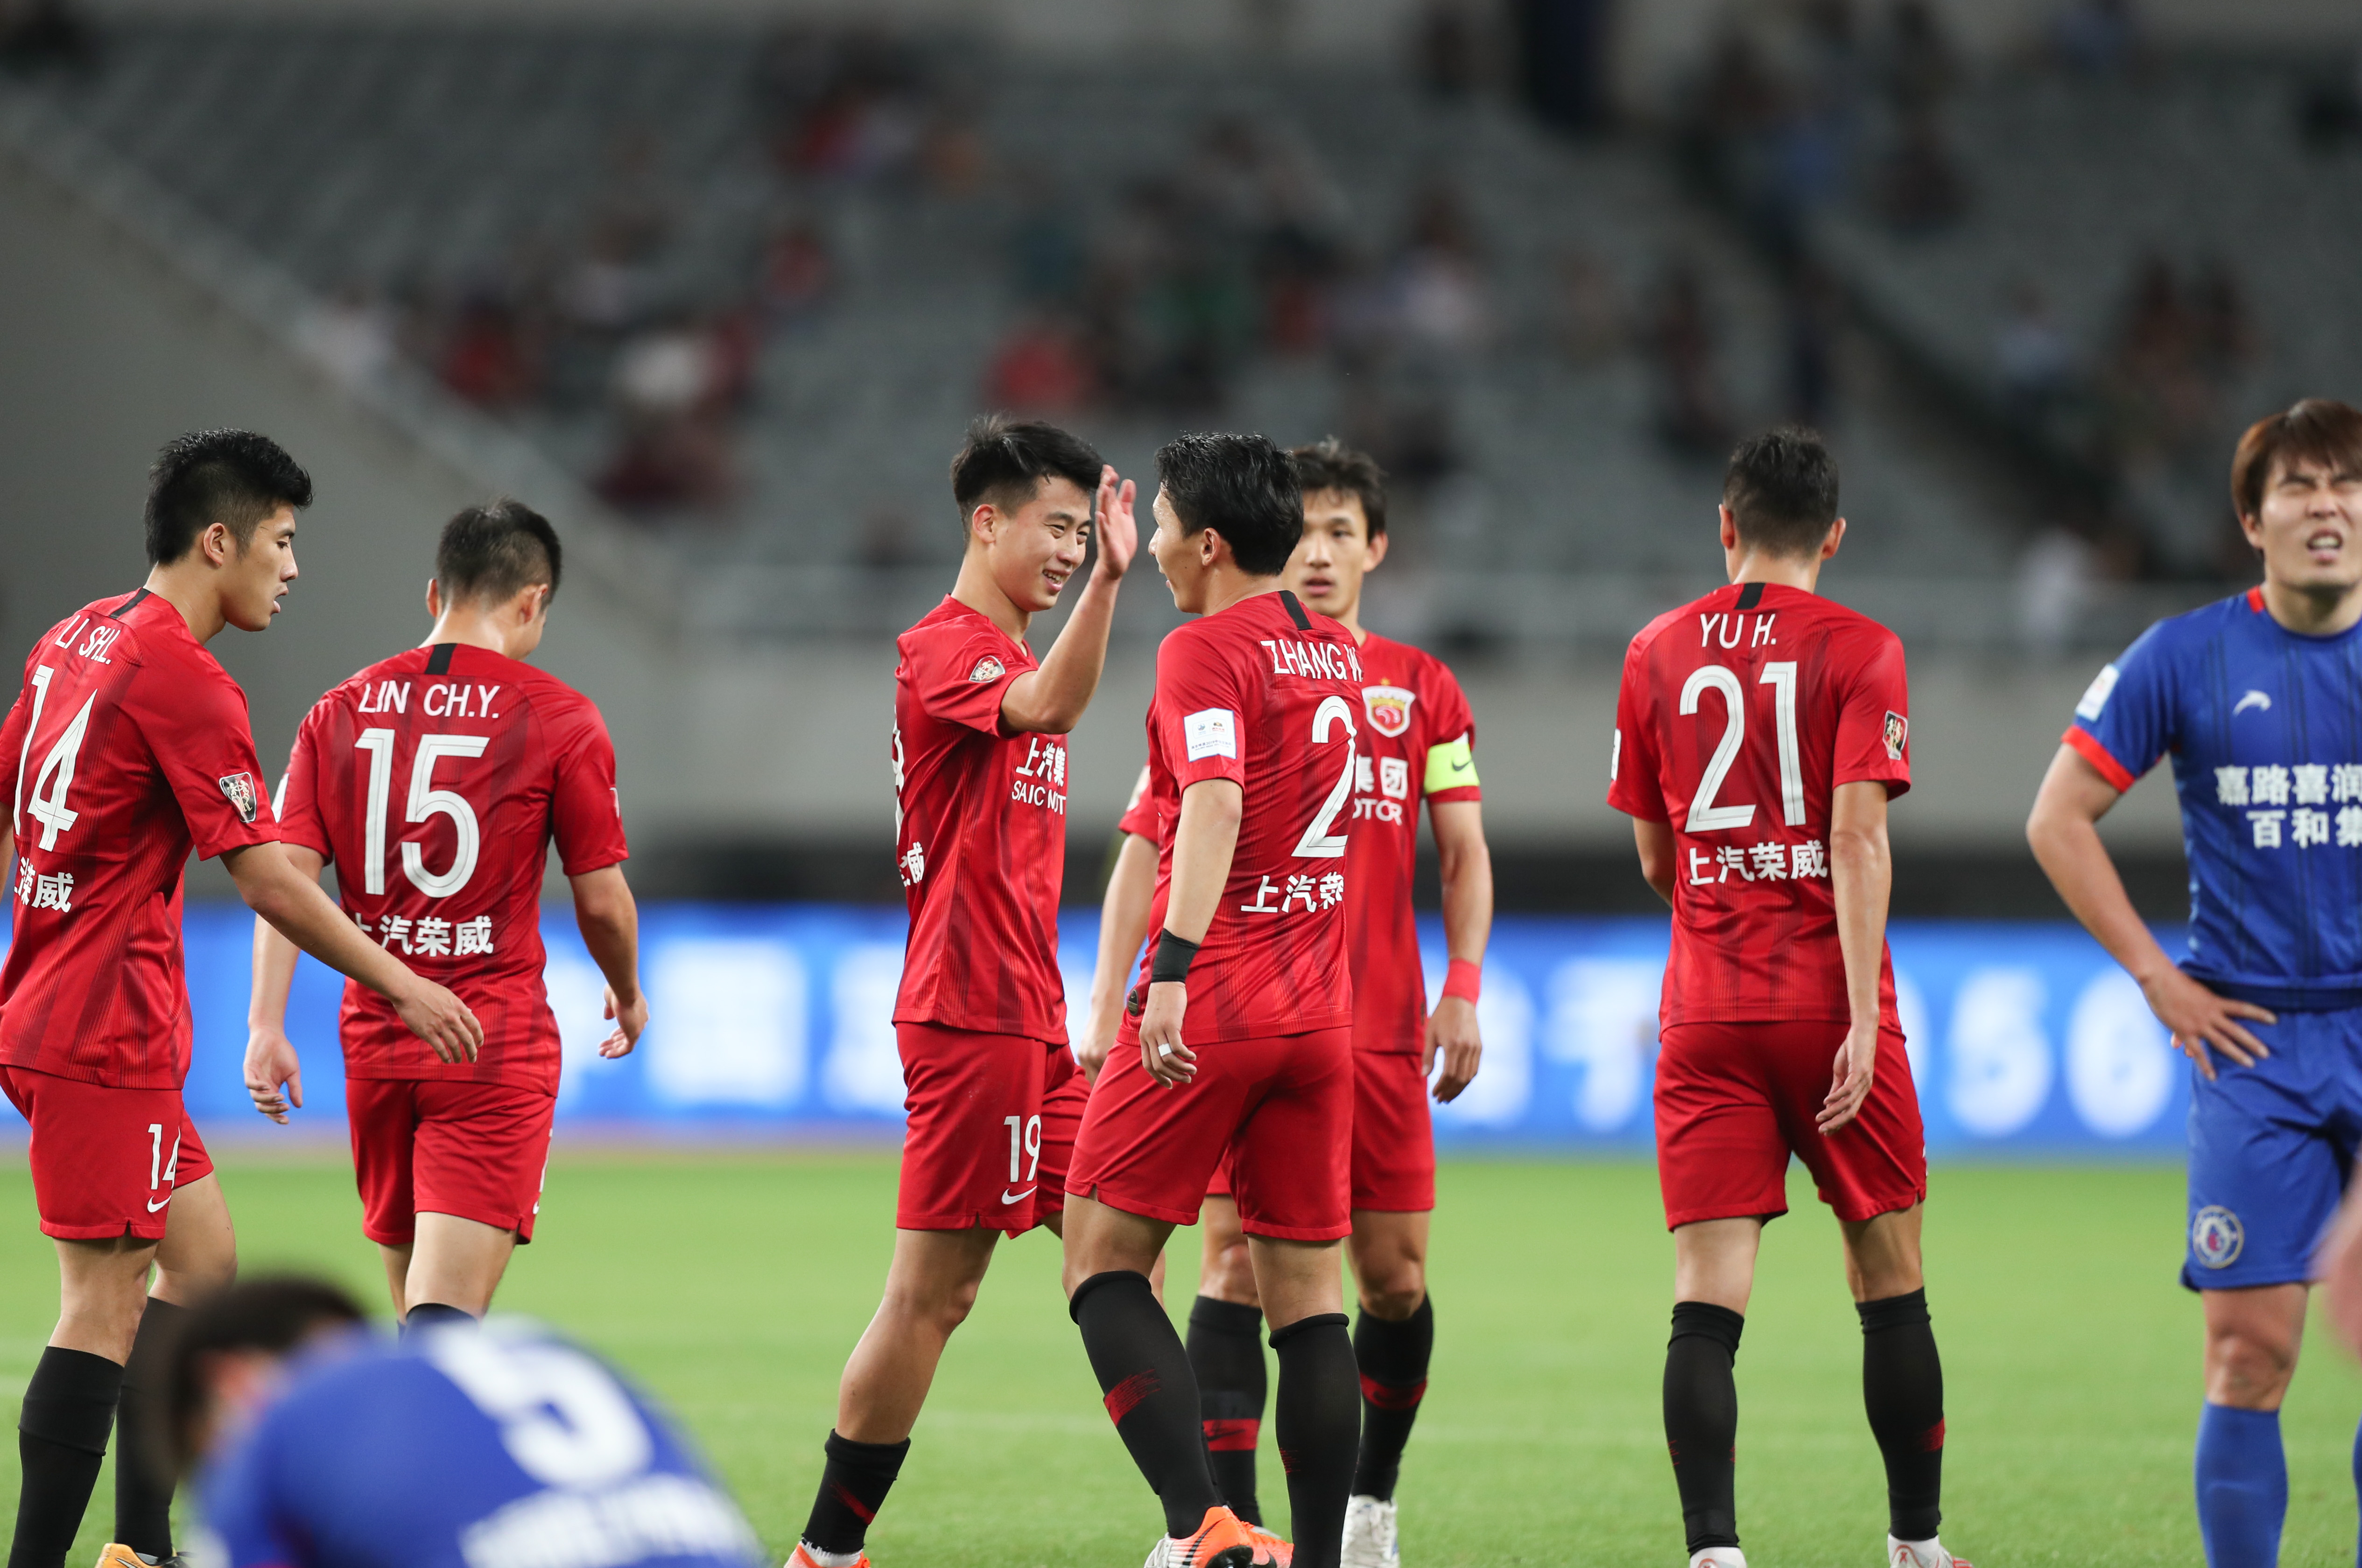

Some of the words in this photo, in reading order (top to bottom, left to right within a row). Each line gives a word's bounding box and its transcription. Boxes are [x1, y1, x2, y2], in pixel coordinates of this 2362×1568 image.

[55, 615, 90, 649] LI
[1700, 613, 1744, 649] YU
[1751, 613, 1777, 648] H.
[1260, 638, 1348, 681] ZHANG
[359, 680, 411, 714] LIN
[13, 664, 98, 852] 14
[1015, 737, 1066, 787] 上汽集
[1679, 661, 1807, 833] 21
[1012, 780, 1046, 806] SAIC
[1290, 695, 1357, 857] 2
[354, 727, 491, 898] 15
[1689, 839, 1828, 886] 上汽荣威
[148, 1124, 181, 1190] 14
[1004, 1114, 1041, 1182] 19
